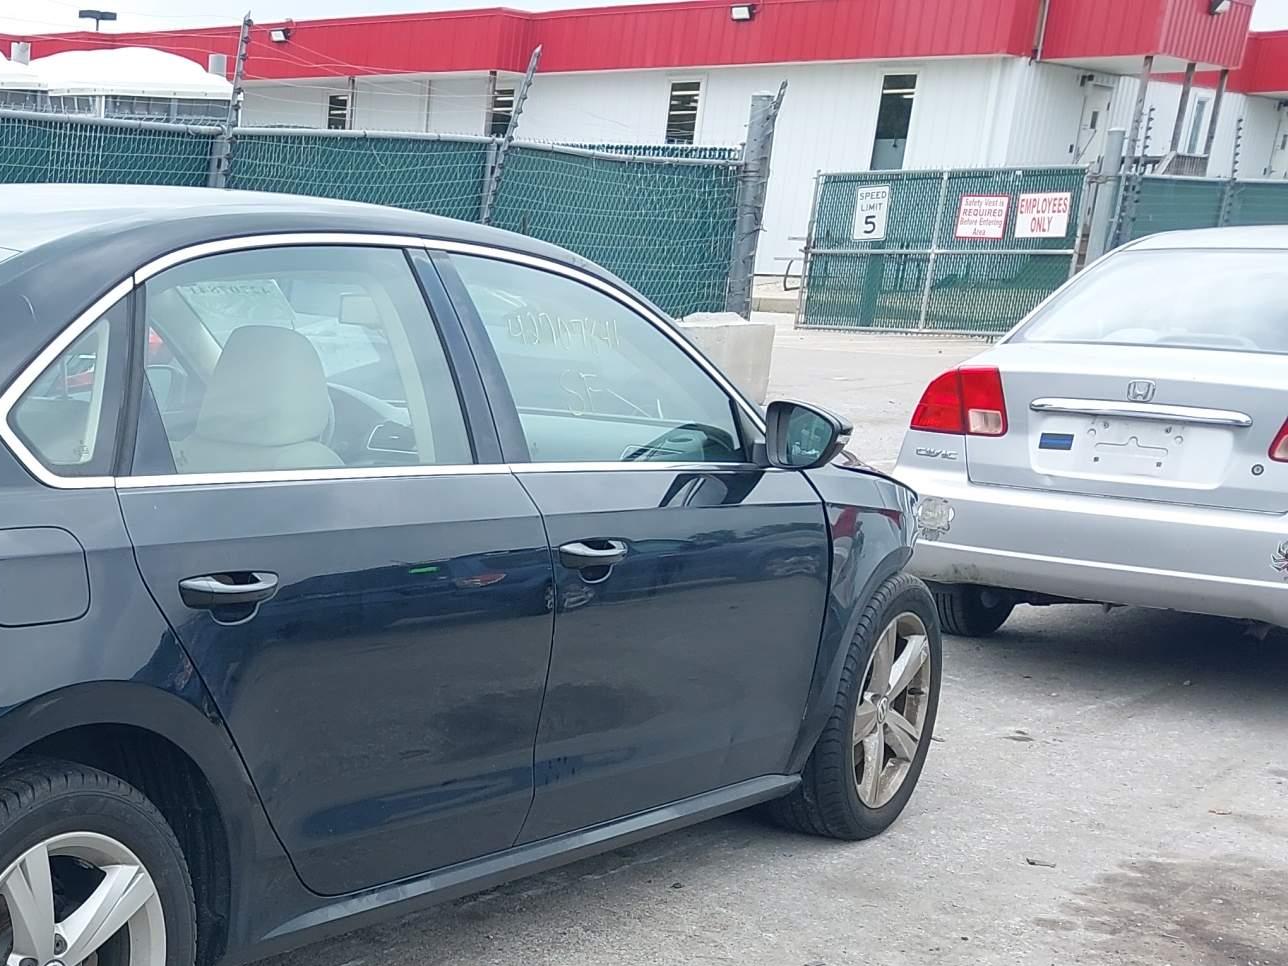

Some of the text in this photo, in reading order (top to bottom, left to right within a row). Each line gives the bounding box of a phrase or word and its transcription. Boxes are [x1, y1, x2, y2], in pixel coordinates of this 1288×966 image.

[859, 190, 887, 200] SPEED
[861, 202, 883, 212] LIMIT
[965, 199, 983, 207] Safety
[1019, 197, 1068, 214] EMPLOYEES
[962, 208, 1004, 217] REQUIRED
[863, 215, 876, 234] 5
[979, 217, 1002, 228] Entering
[1030, 215, 1053, 233] ONLY
[972, 228, 986, 236] Area
